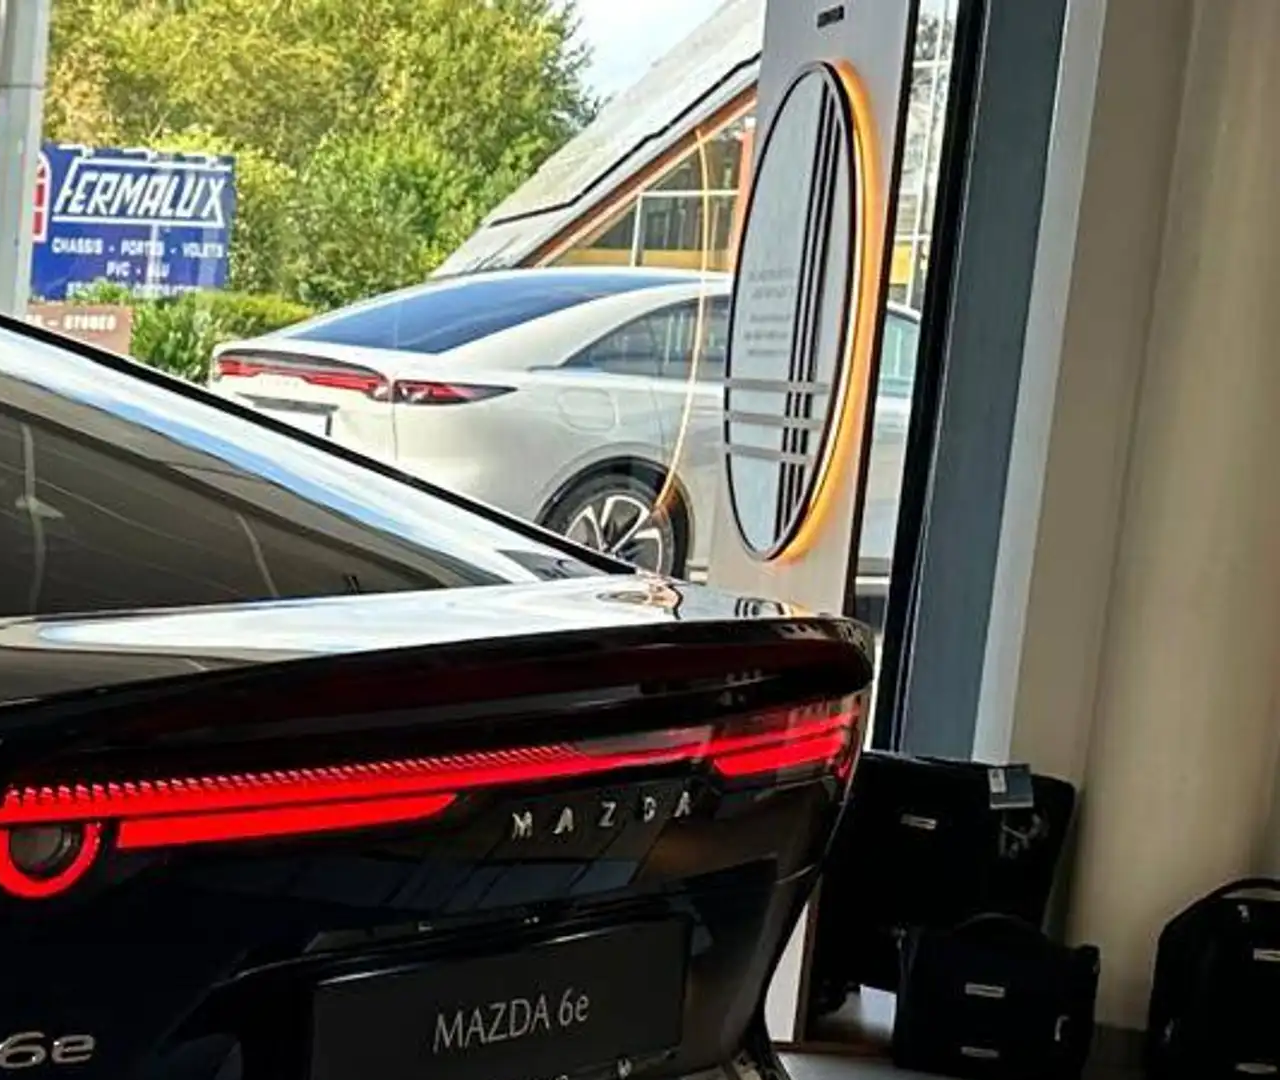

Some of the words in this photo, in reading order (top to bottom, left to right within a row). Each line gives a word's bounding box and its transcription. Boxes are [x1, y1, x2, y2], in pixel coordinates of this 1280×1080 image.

[53, 157, 228, 220] FERMALUX
[51, 236, 104, 255] CHASSIS
[511, 791, 691, 840] MAZDA
[432, 992, 550, 1054] MAZDA
[559, 987, 590, 1027] 6e
